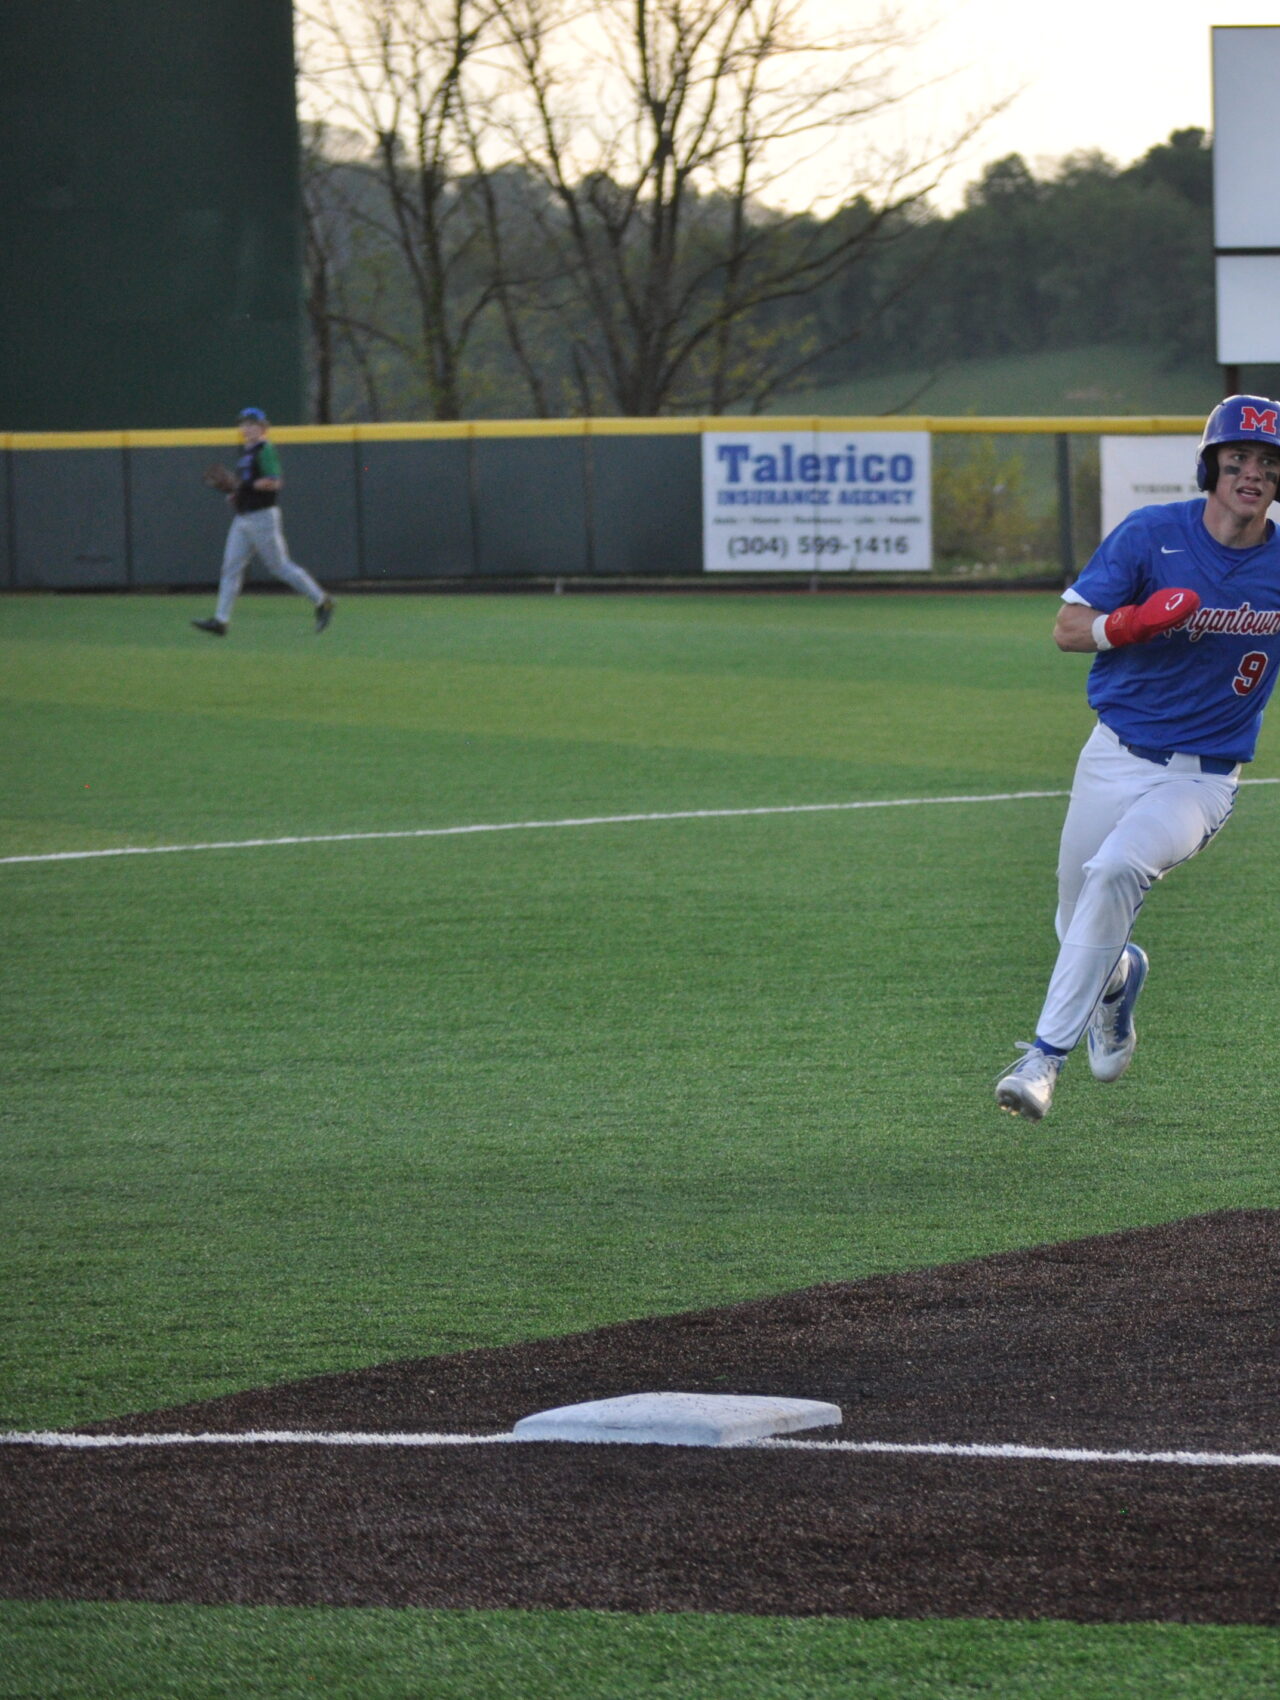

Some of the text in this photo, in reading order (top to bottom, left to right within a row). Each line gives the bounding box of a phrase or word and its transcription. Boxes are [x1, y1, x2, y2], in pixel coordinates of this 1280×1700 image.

[1240, 406, 1278, 435] M
[717, 444, 914, 484] Talerico
[717, 488, 915, 506] INSURANCE AGENCY
[728, 535, 910, 559] (304) 599-1416
[1232, 651, 1268, 696] 9
